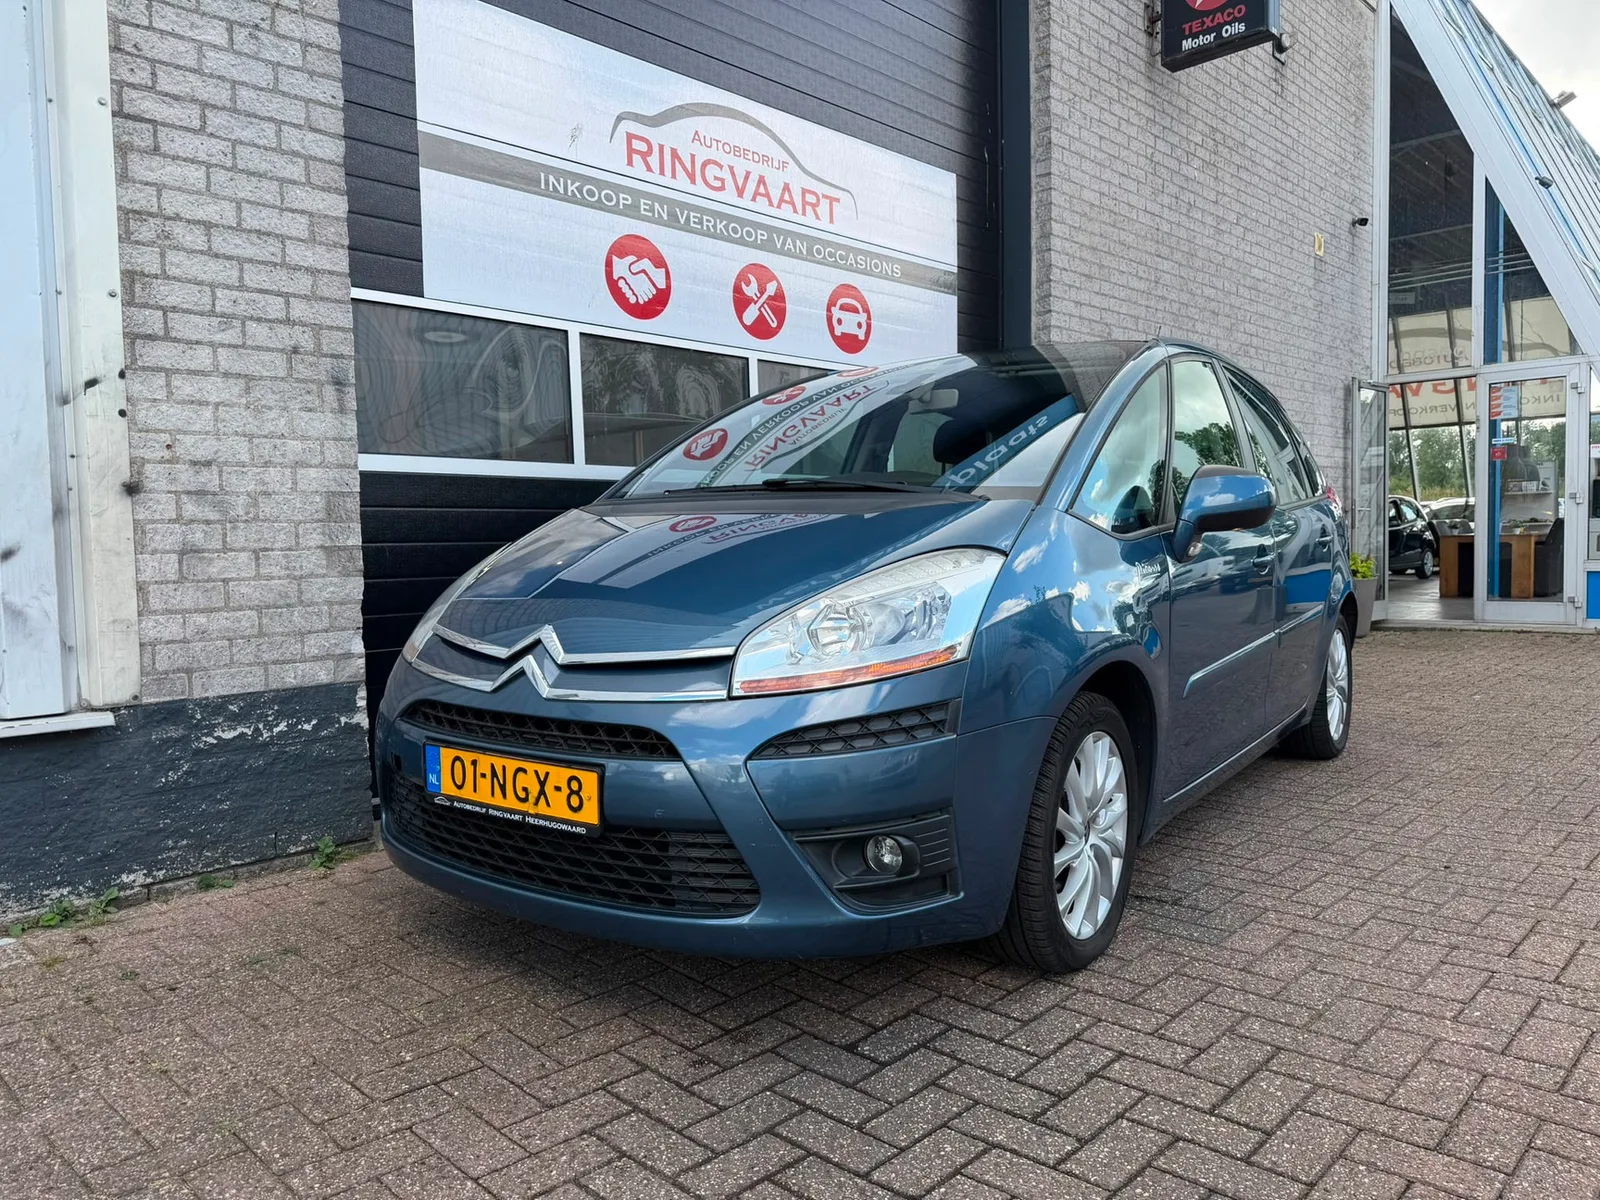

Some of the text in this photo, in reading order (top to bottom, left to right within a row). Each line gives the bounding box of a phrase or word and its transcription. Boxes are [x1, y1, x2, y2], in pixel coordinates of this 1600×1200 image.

[1182, 4, 1246, 35] TEXACO
[1182, 22, 1246, 51] Motor Oils
[691, 130, 789, 172] AUTOBEDRIJF
[625, 131, 841, 225] RINGVAART
[540, 172, 901, 278] INKOOP EN VERKOOP VAN OCCASIONS
[429, 755, 584, 813] NL 01-NGX-8
[453, 801, 587, 834] AUTOBEDRIJF RINGVAART HEERHUGOWAARD
